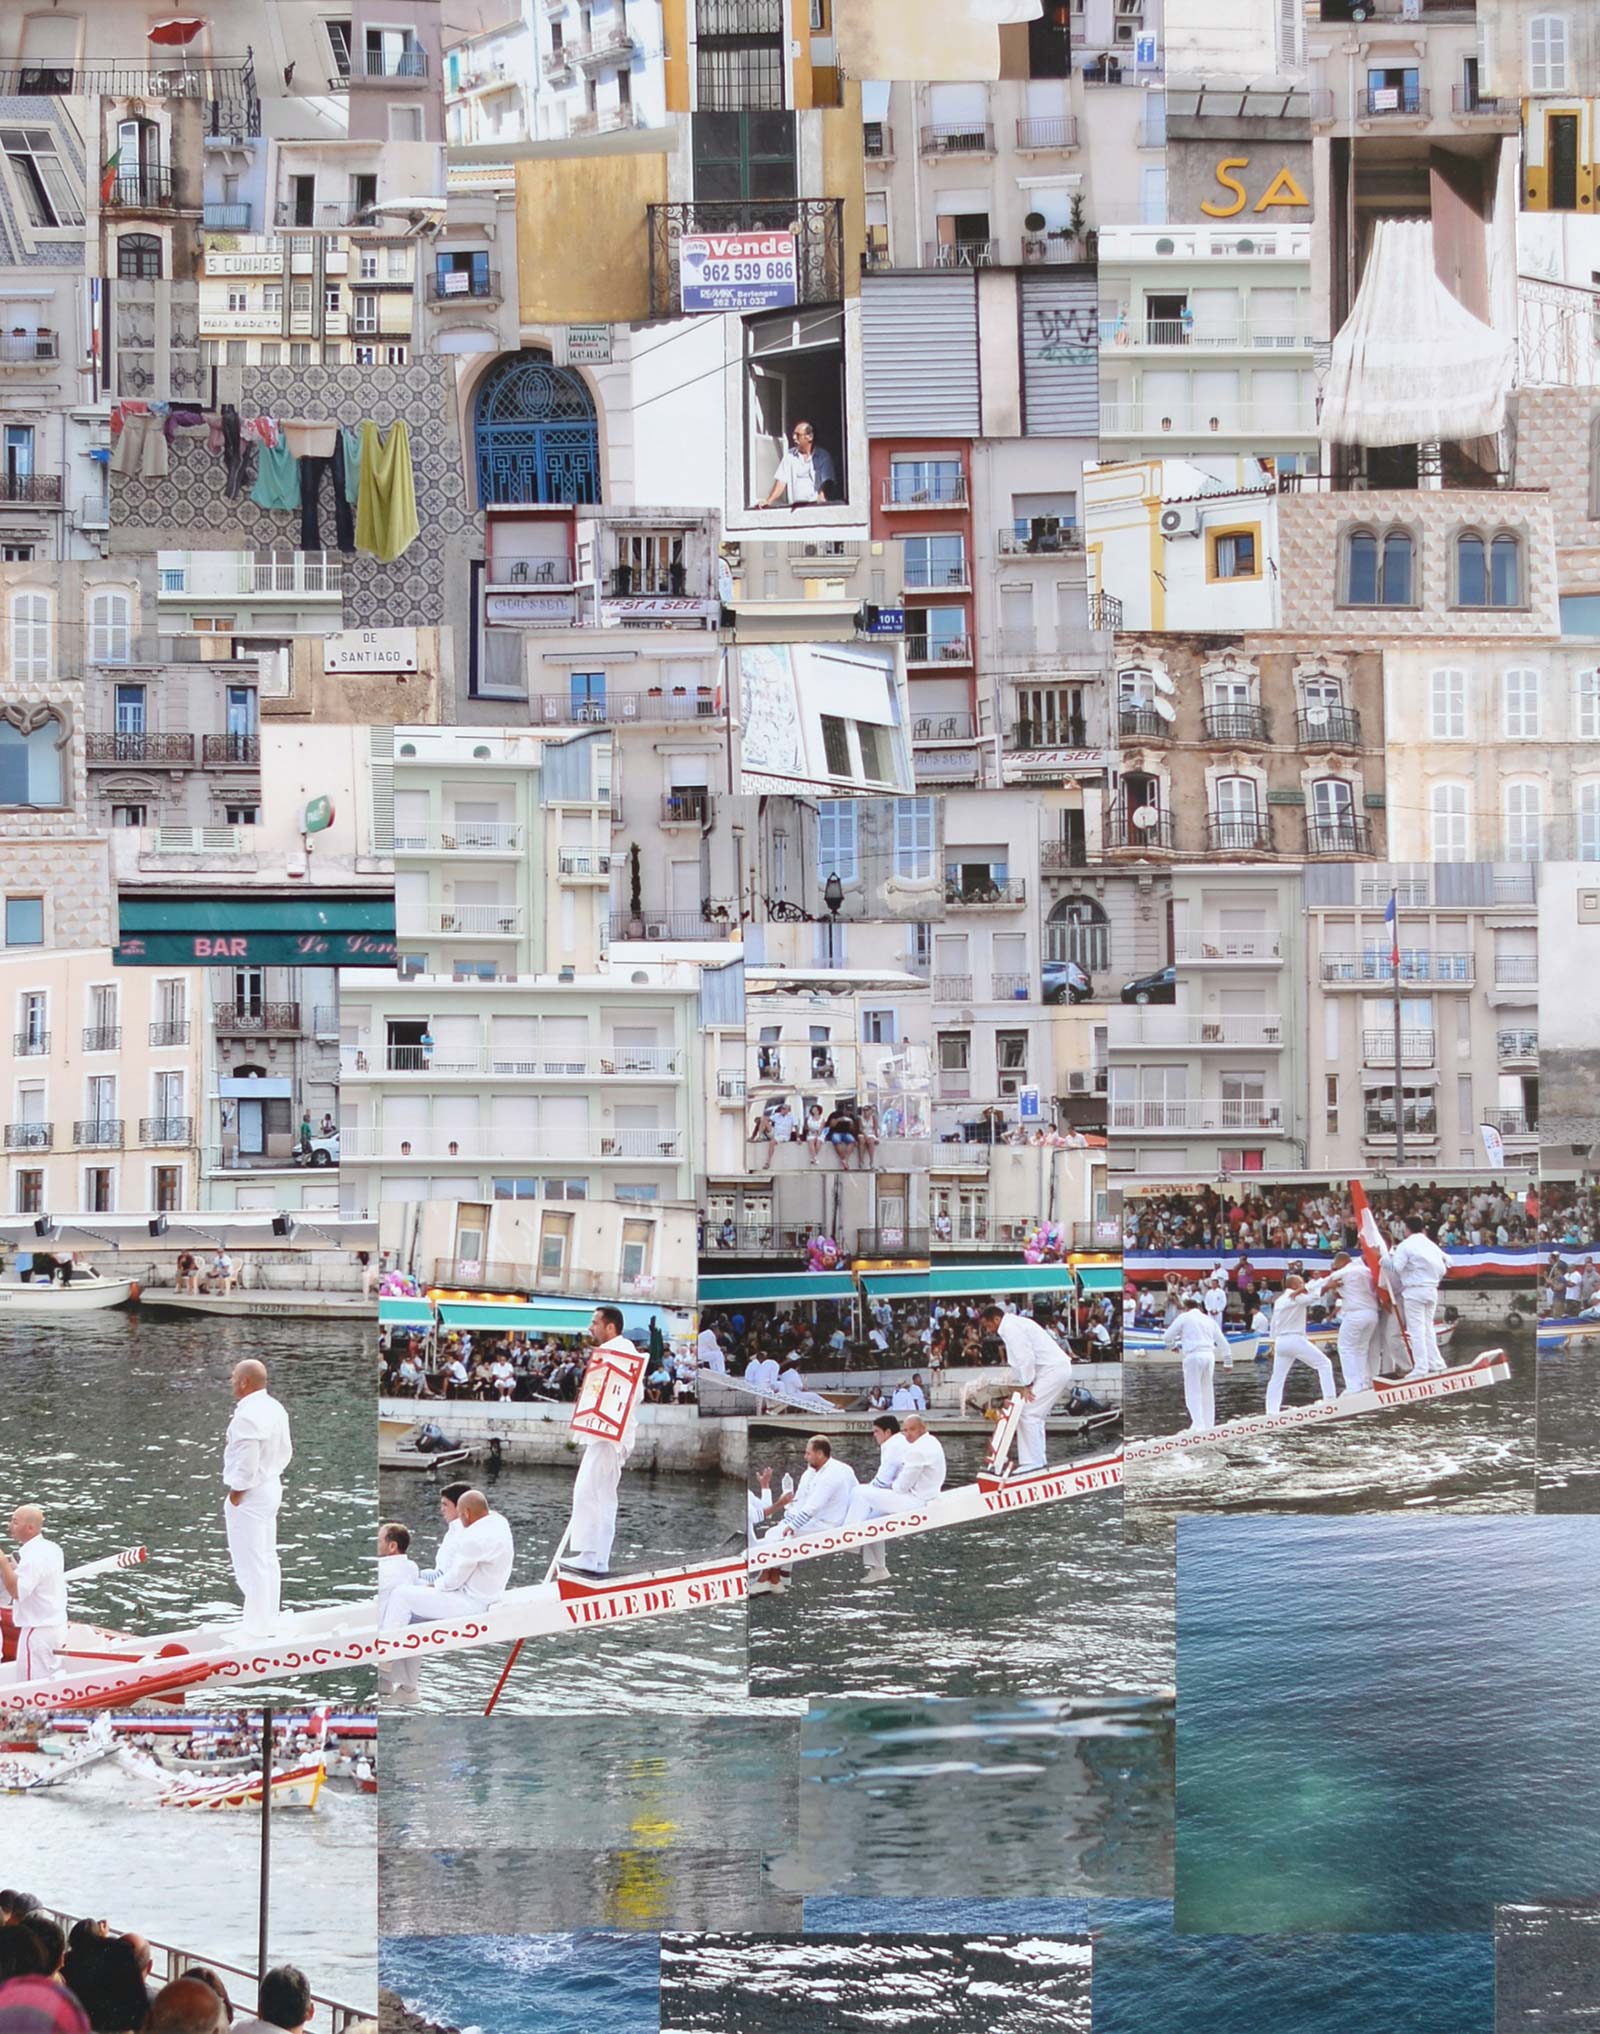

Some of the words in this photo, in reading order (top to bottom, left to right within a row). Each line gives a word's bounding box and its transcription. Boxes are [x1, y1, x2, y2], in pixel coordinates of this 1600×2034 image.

[1200, 156, 1310, 218] SA
[710, 237, 793, 257] Vende
[223, 257, 282, 272] CUNHAS
[702, 264, 730, 281] 962
[734, 263, 761, 280] 539
[766, 262, 793, 279] 686
[880, 615, 903, 624] 101.1
[363, 632, 378, 643] DE
[341, 651, 401, 662] SANTIAGO
[193, 938, 247, 957] BAR
[297, 935, 329, 953] Le
[1378, 1387, 1417, 1405] VILLE
[1418, 1383, 1437, 1397] DE
[1442, 1375, 1478, 1392] SETE
[984, 1486, 1040, 1511] VILLE
[1041, 1480, 1068, 1499] DE
[1074, 1467, 1123, 1492] SETE
[566, 1593, 640, 1624] VILLE
[643, 1588, 676, 1612] DE
[687, 1575, 749, 1605] SETE
